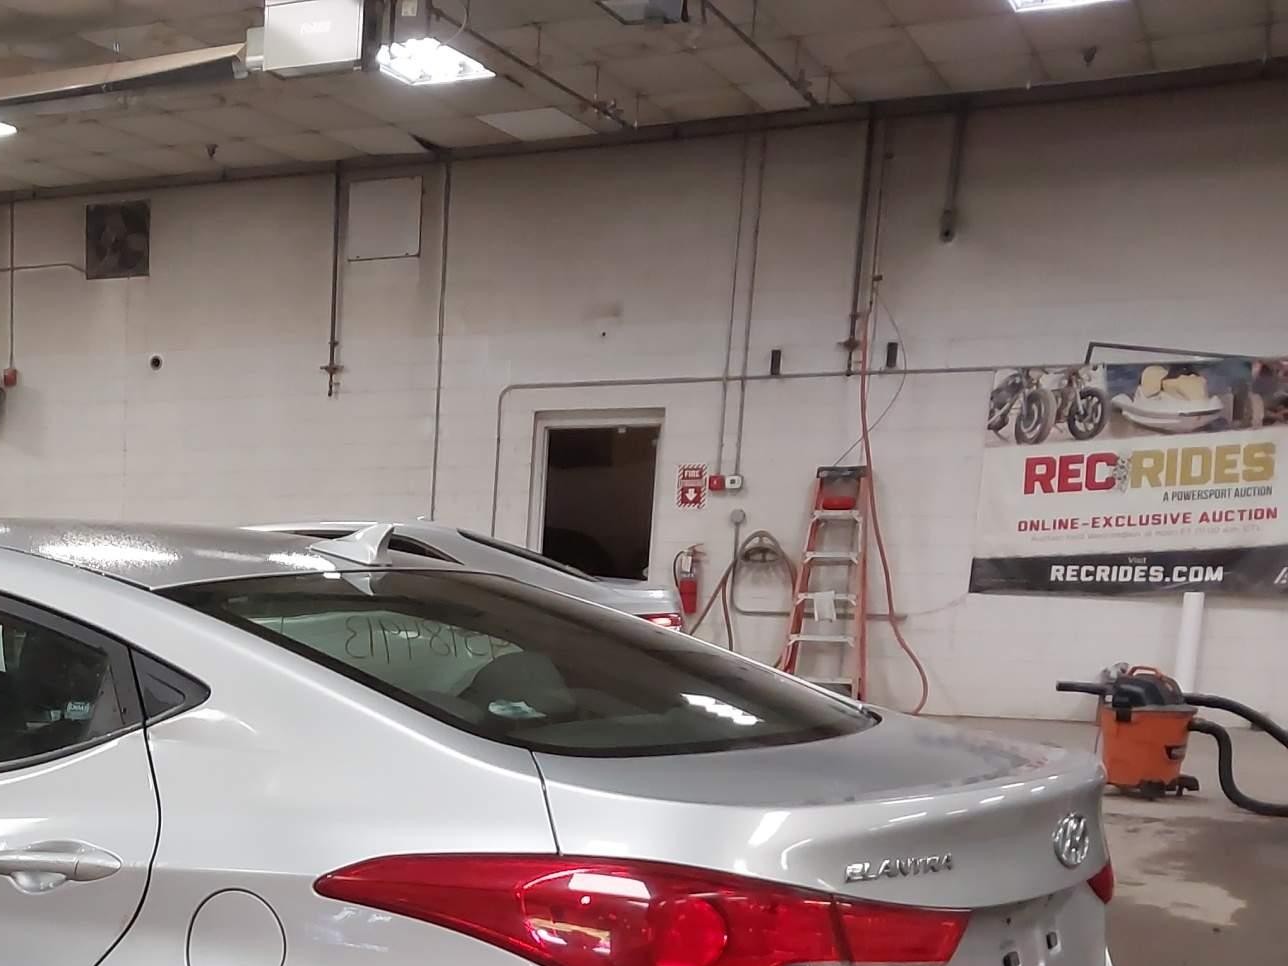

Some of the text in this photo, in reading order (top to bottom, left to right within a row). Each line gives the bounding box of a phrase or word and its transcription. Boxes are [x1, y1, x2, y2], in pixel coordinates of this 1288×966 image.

[1024, 443, 1276, 494] REC RIDES
[1163, 485, 1273, 502] A POWERSPORT AUCTION
[1018, 507, 1278, 531] ONLINE-EXCLUSIVE AUCTION
[1050, 565, 1224, 582] RECRIDES.COM
[845, 854, 954, 883] ELANTRA
